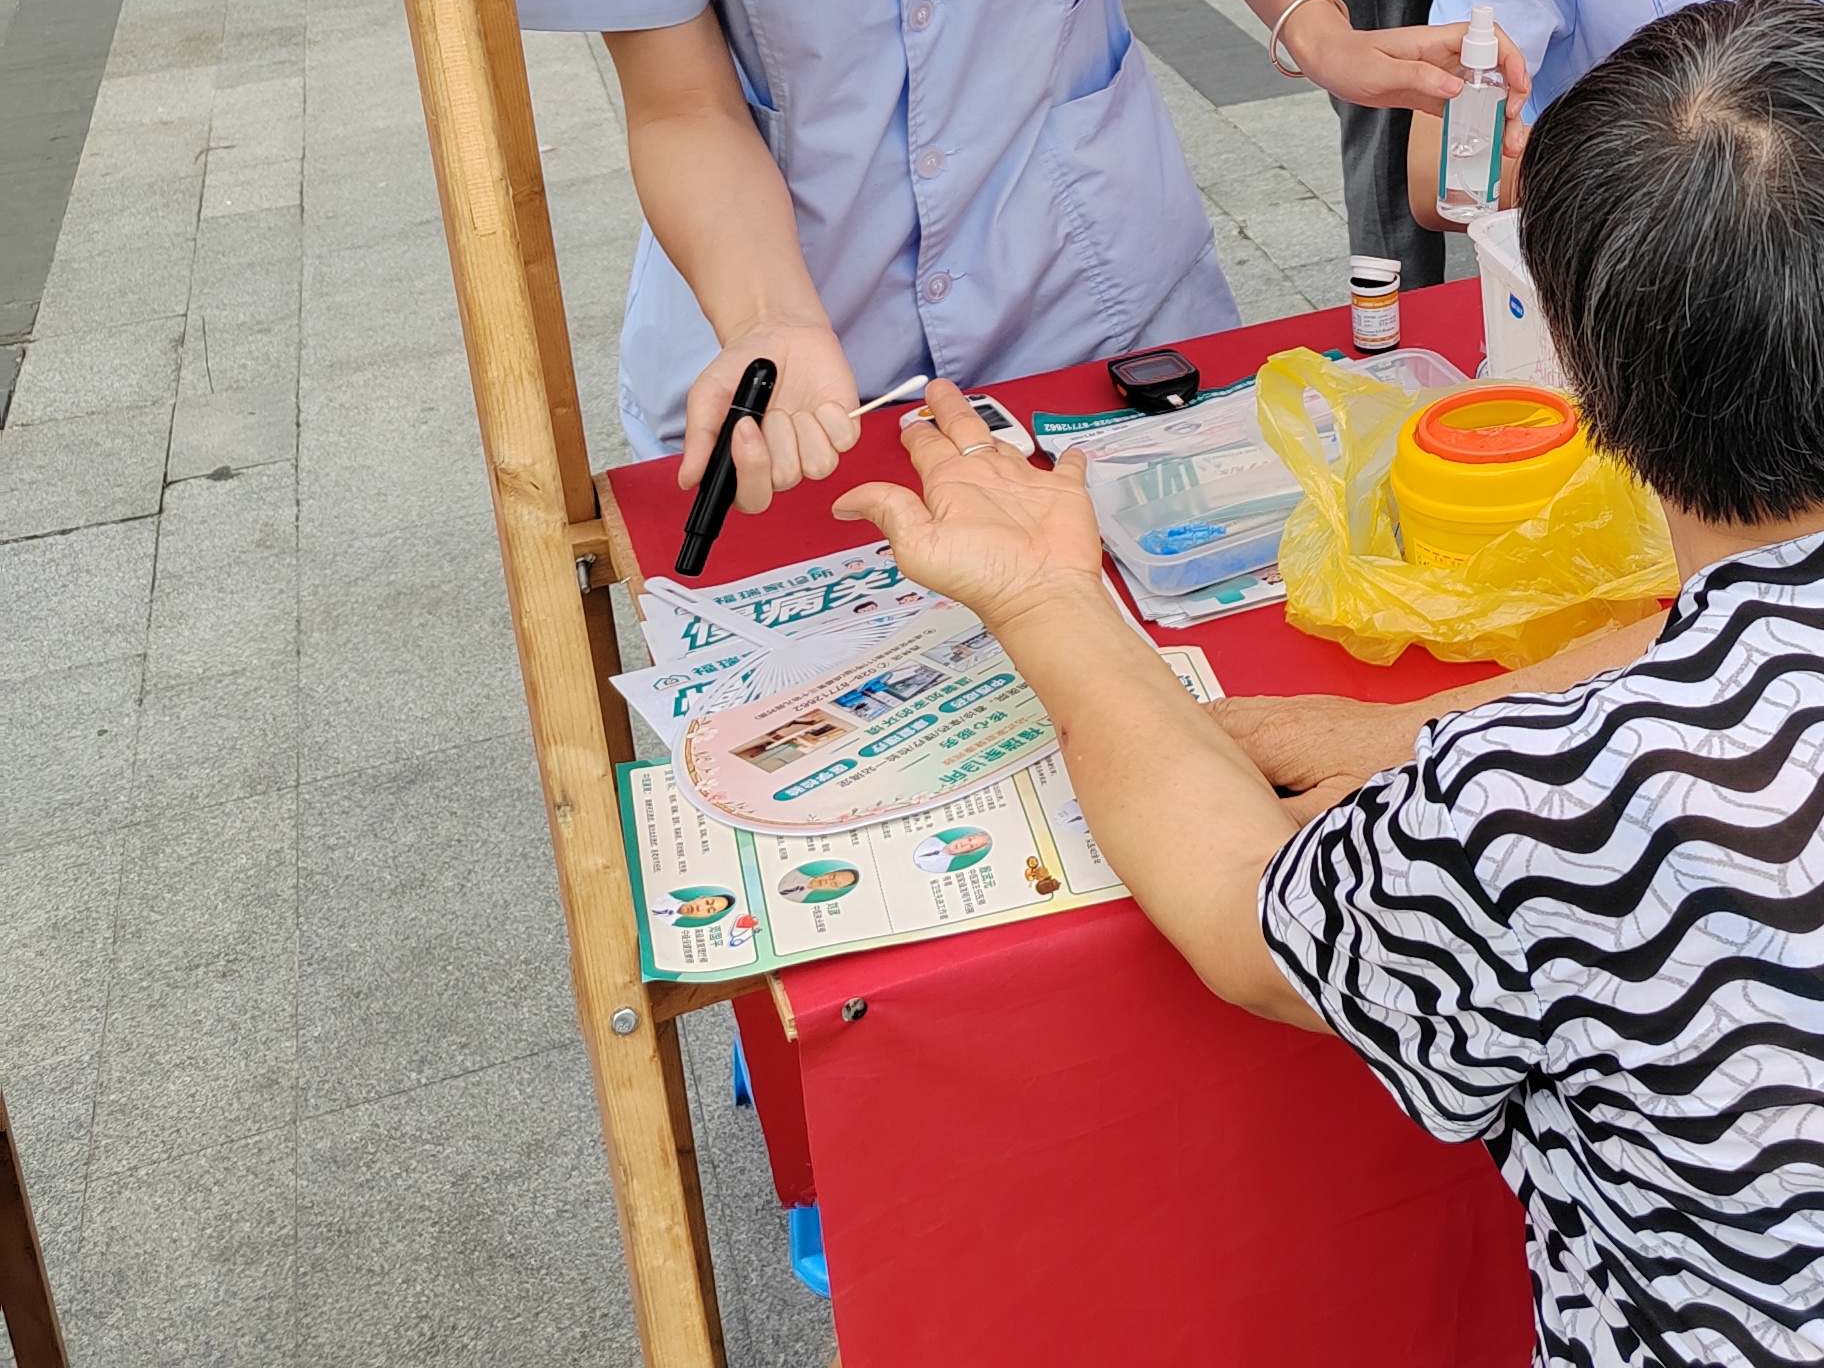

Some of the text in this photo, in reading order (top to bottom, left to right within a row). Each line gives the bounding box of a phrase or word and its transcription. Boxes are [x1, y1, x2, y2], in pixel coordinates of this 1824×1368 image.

[684, 563, 905, 651] 慢病关
[938, 710, 1009, 750] 核心服务
[938, 726, 1045, 786] 福瑞家诊所
